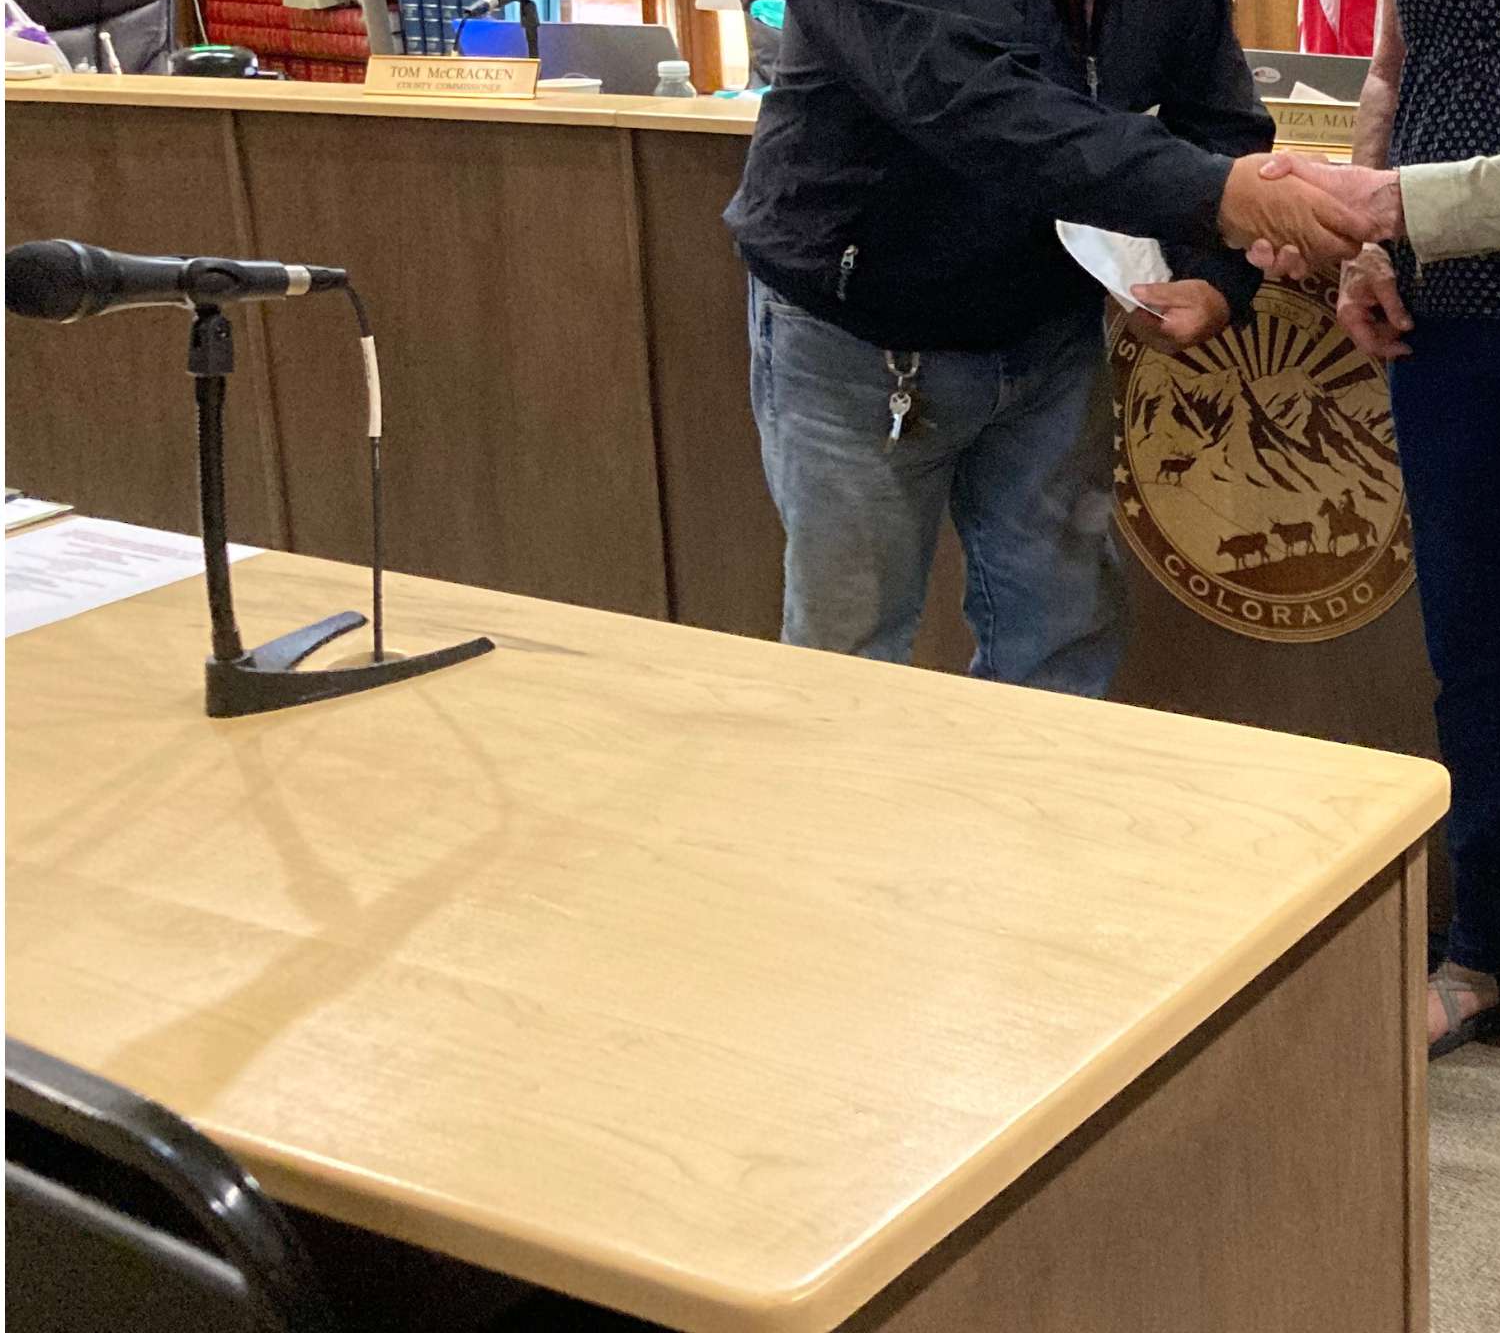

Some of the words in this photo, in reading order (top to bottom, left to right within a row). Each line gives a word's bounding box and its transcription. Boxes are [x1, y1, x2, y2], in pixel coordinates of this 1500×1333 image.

[390, 65, 420, 78] TOM
[428, 67, 515, 80] McCRACKEN
[1163, 552, 1375, 625] COLORADO
